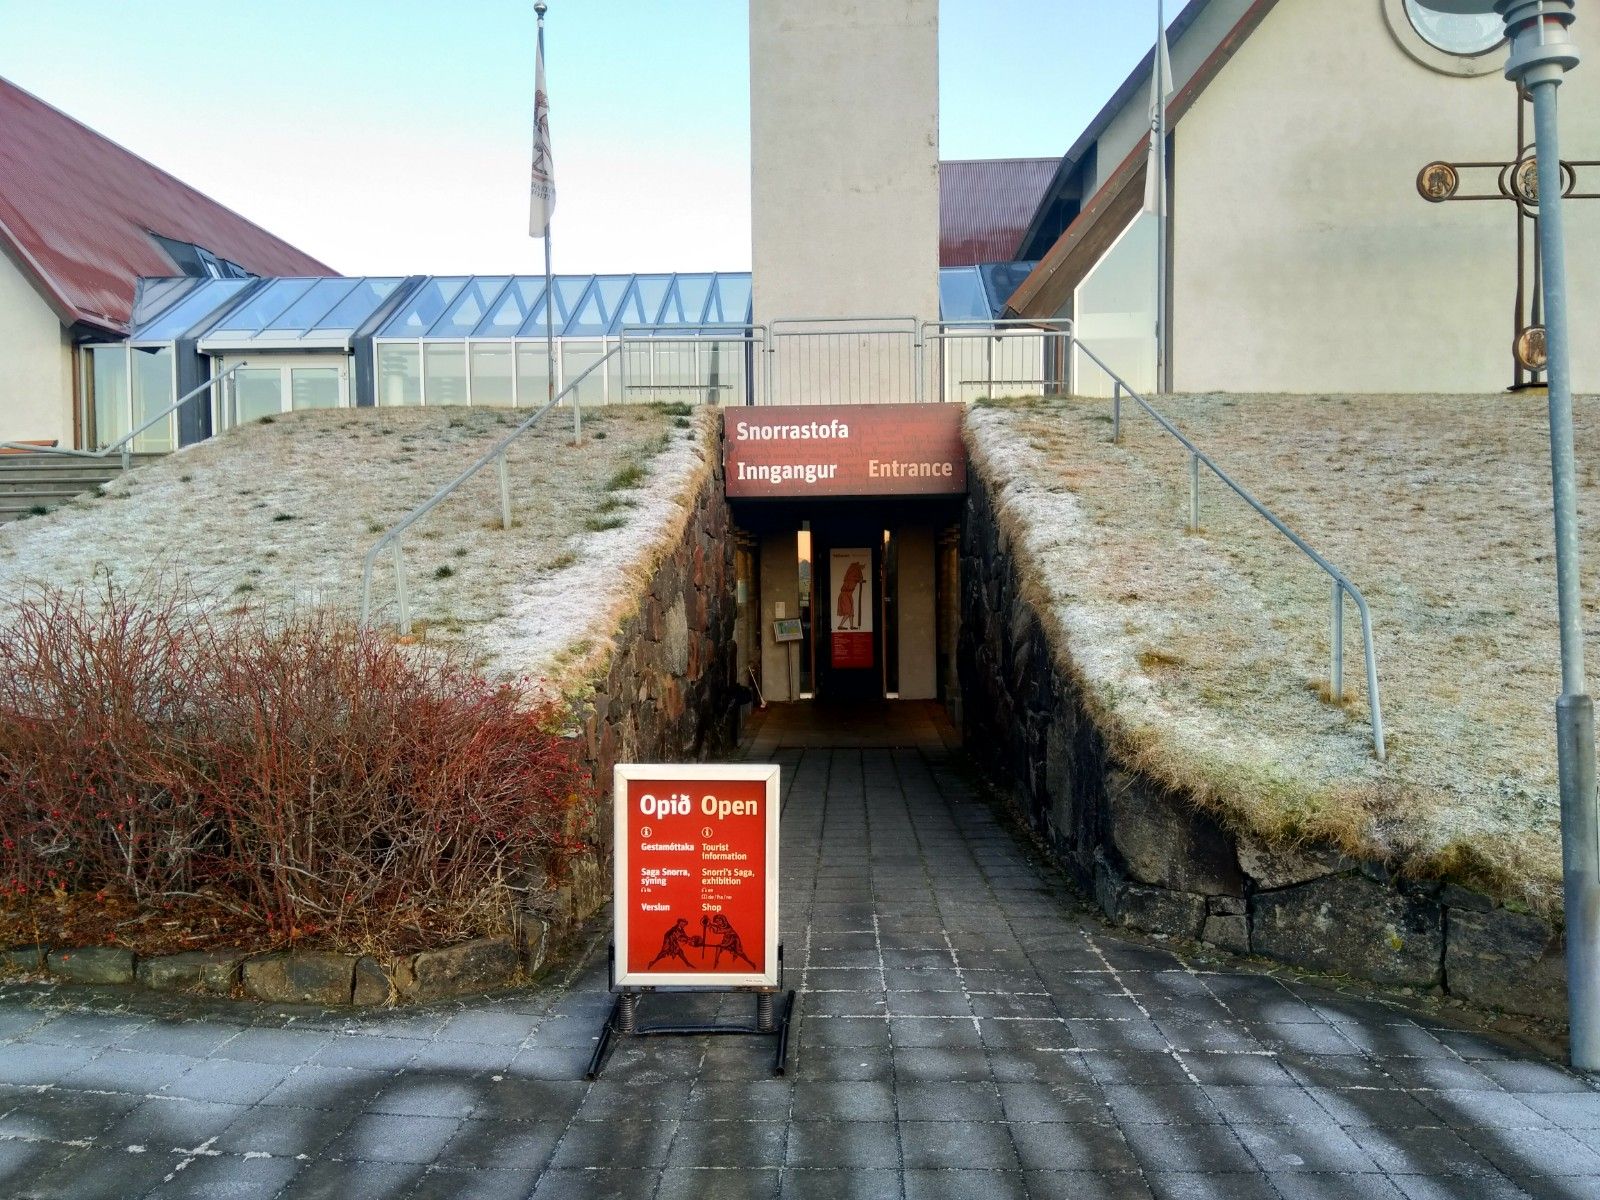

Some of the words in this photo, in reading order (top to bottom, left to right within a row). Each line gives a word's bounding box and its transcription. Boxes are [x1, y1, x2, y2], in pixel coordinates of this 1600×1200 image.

[736, 420, 849, 441] Snorrastofa
[737, 462, 838, 483] Inngangur
[868, 459, 953, 478] Entrance
[639, 793, 692, 820] Opið
[701, 795, 758, 820] Open
[640, 842, 695, 852] Gestamóttaka
[701, 843, 729, 852] Tourist
[701, 852, 747, 860] Information
[640, 868, 660, 877] Saga
[661, 868, 691, 877] Snorra,
[701, 868, 732, 877] Snorri's
[733, 868, 755, 877] Saga,
[640, 877, 667, 887] sýning
[701, 877, 741, 885] exhibition
[640, 903, 671, 911] Verslun
[701, 903, 722, 912] Shop
